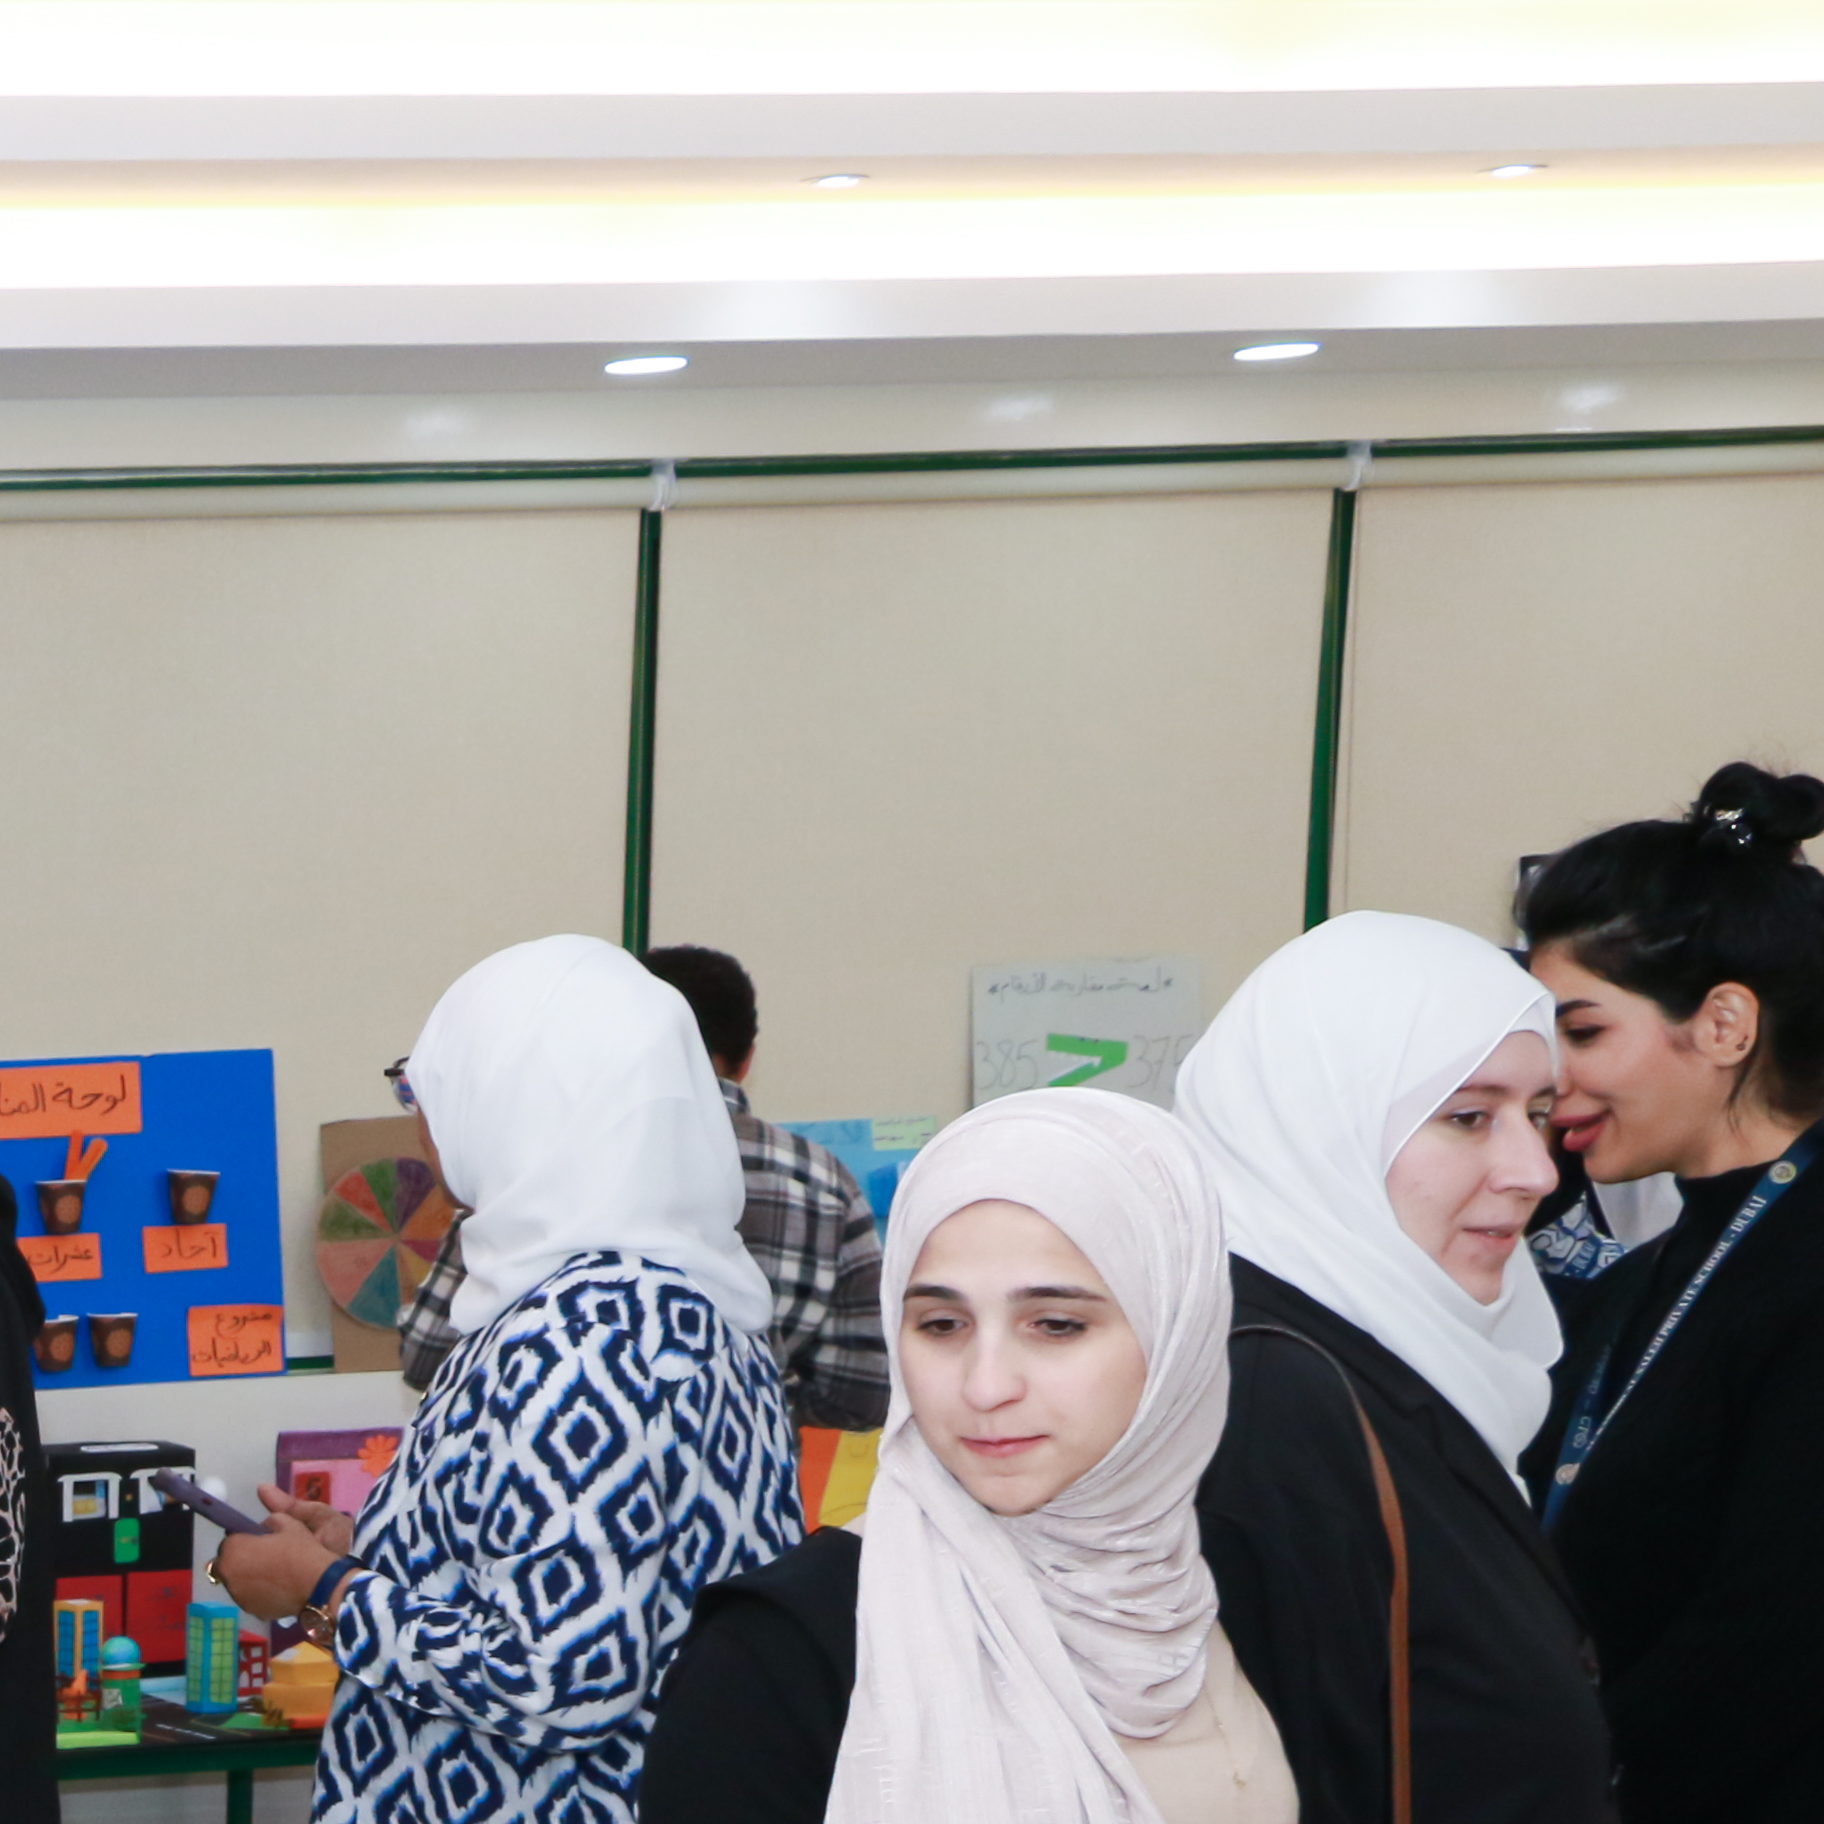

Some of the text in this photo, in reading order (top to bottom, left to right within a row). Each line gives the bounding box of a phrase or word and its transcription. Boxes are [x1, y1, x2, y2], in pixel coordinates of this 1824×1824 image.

[976, 1038, 1040, 1091] 385
[52, 1073, 127, 1116] لوحة
[1730, 1195, 1767, 1232] DUBAI
[26, 1242, 94, 1275] عشرات
